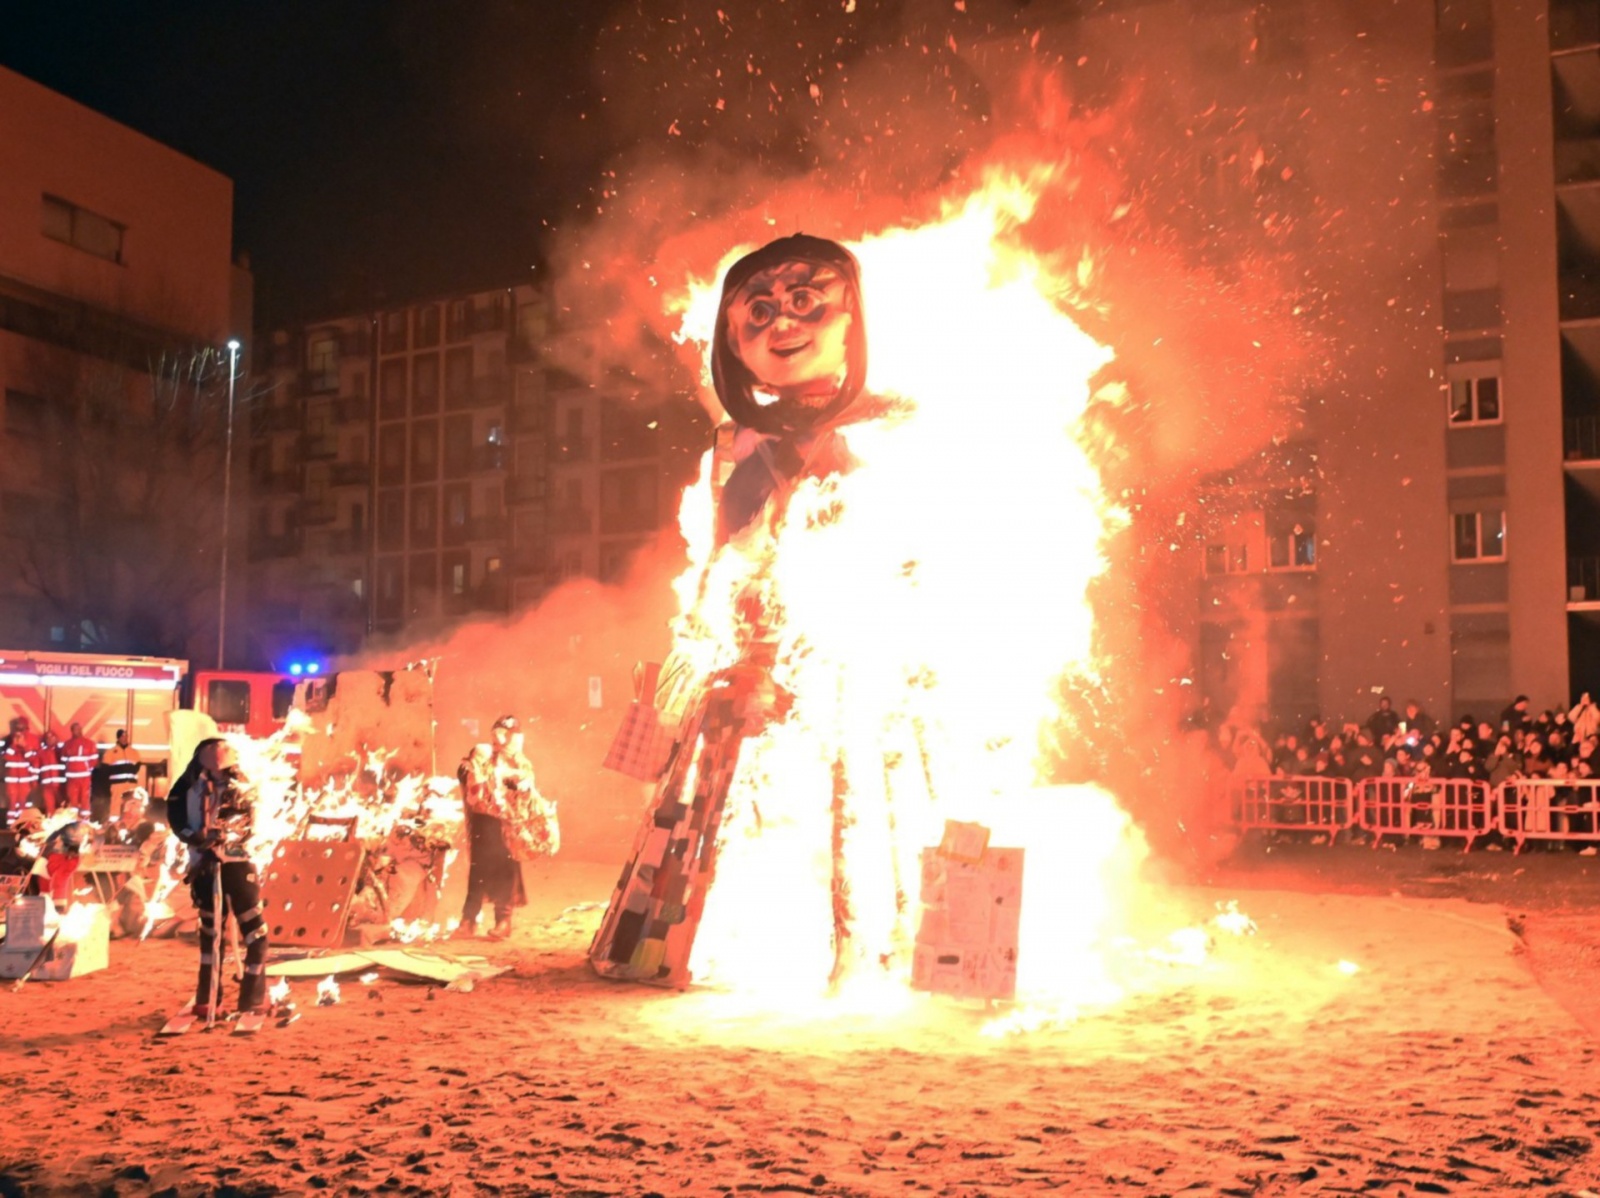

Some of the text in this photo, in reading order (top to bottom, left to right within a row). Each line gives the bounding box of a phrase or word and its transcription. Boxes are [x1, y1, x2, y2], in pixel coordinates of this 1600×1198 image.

[35, 663, 134, 678] VIGILI DEL FUOCO
